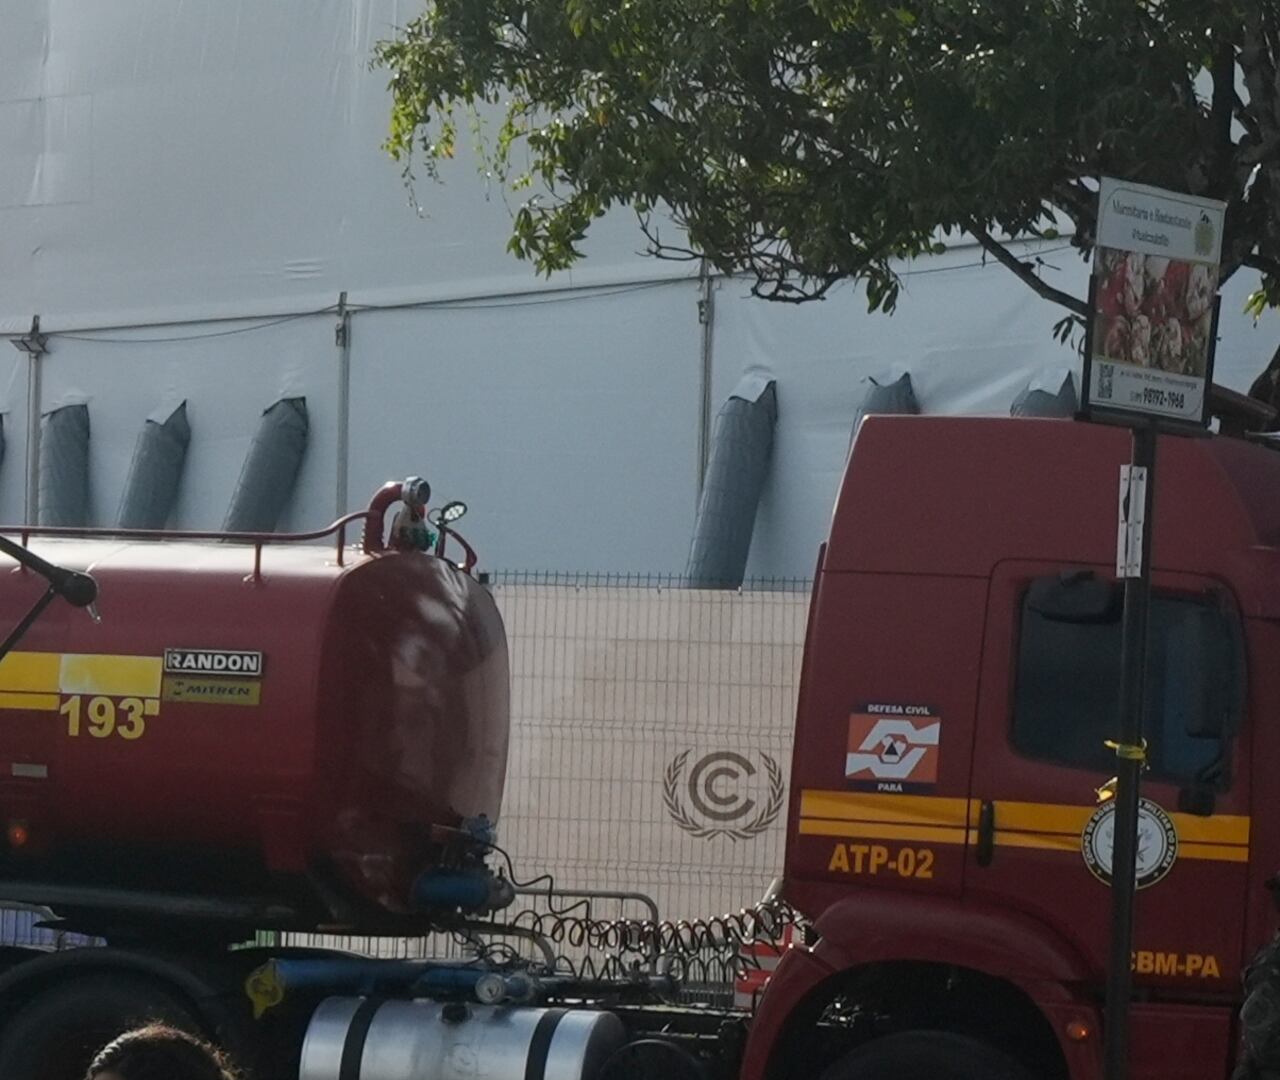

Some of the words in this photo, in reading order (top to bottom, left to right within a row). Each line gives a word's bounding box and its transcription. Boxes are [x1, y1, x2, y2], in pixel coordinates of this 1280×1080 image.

[167, 652, 258, 672] RANDON
[186, 683, 251, 697] MITREN
[60, 695, 146, 740] 193
[868, 704, 903, 715] DEFESA
[905, 705, 931, 716] CIVIL
[828, 842, 935, 879] ATP-02
